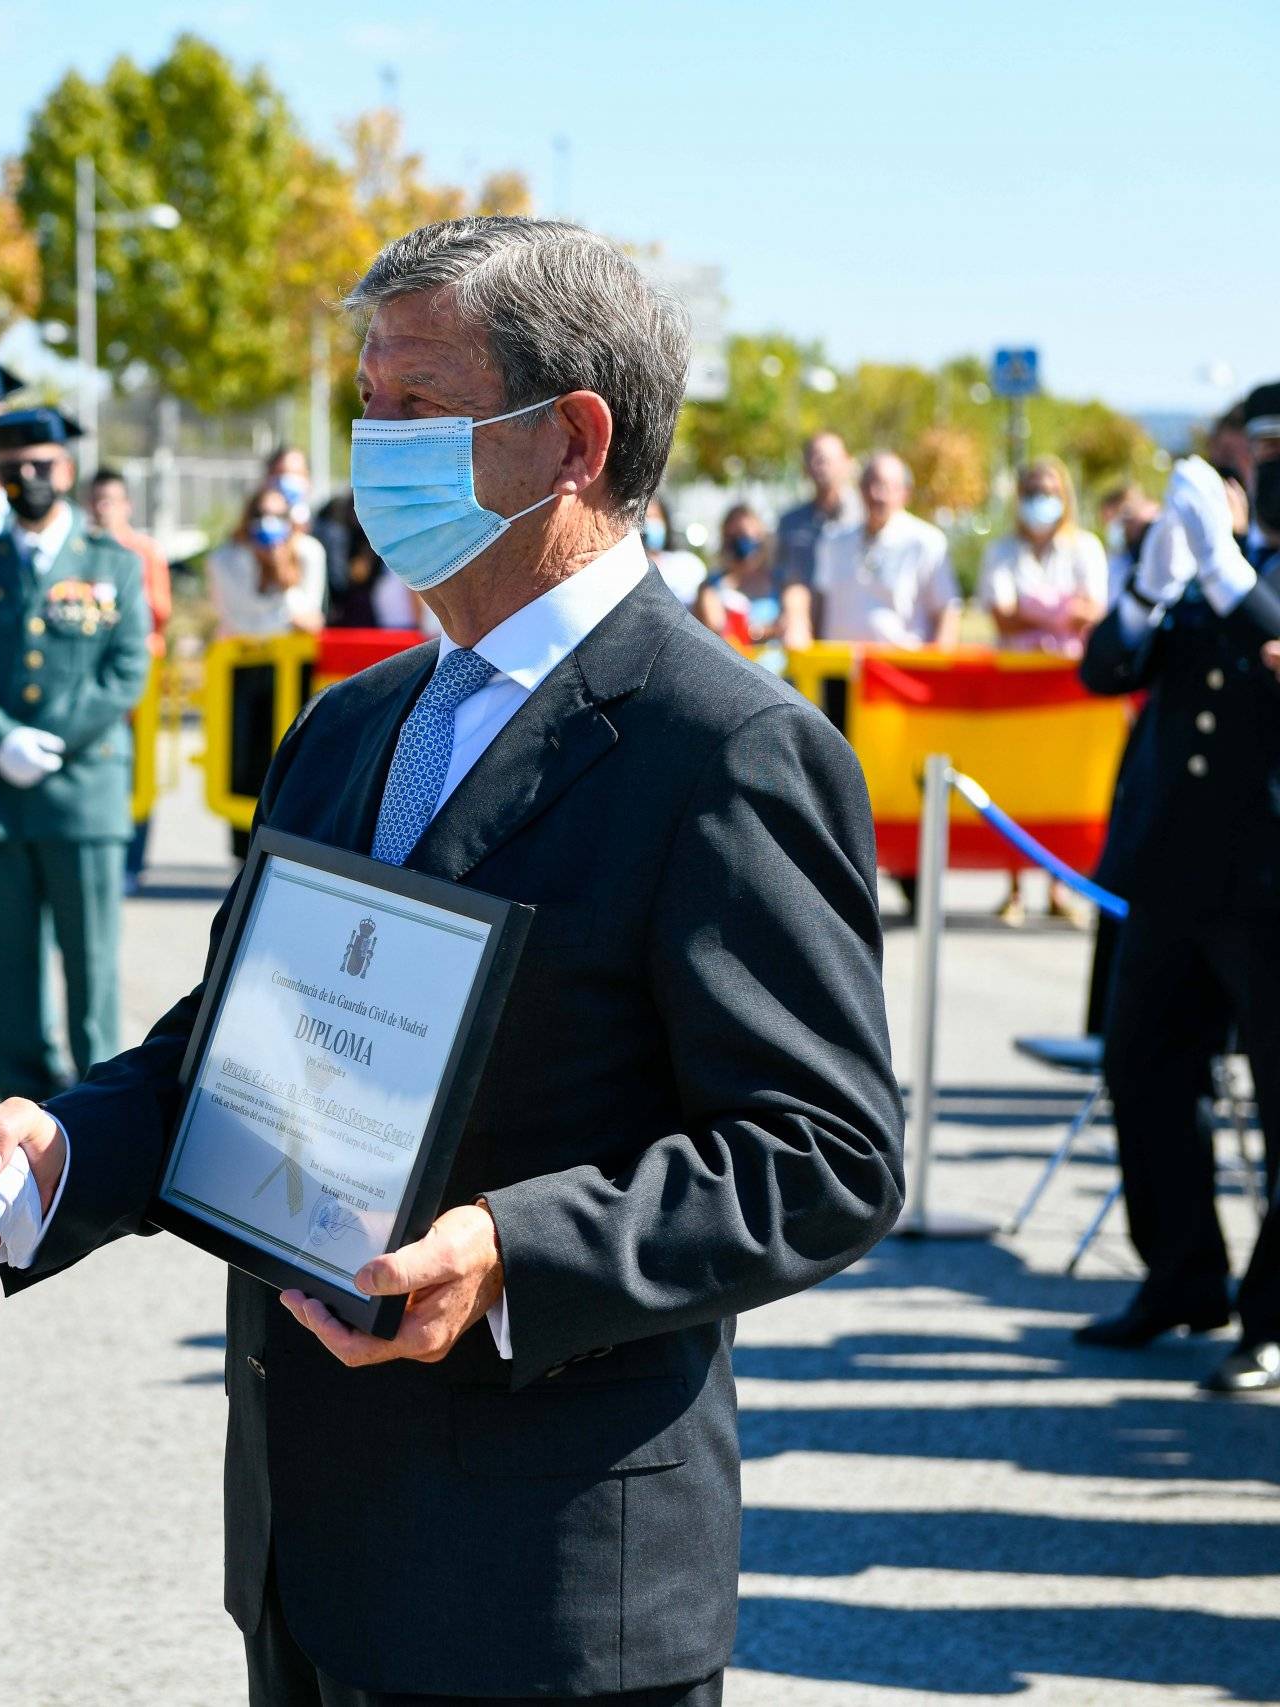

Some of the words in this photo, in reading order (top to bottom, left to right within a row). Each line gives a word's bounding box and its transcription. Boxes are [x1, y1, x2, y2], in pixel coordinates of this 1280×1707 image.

[270, 969, 319, 998] Comandancia
[318, 987, 329, 1001] de
[327, 990, 337, 1004] la
[336, 993, 368, 1016] Guardia
[367, 1005, 387, 1023] Civil
[387, 1012, 398, 1027] de
[396, 1015, 428, 1038] Madrid
[292, 1013, 377, 1066] DIPLOMA
[228, 1100, 250, 1117] beneficio
[256, 1113, 275, 1127] servicio
[327, 1186, 356, 1205] CORONEL
[354, 1198, 370, 1212] JEFE
[350, 1177, 369, 1192] octubre
[373, 1187, 386, 1199] 2021
